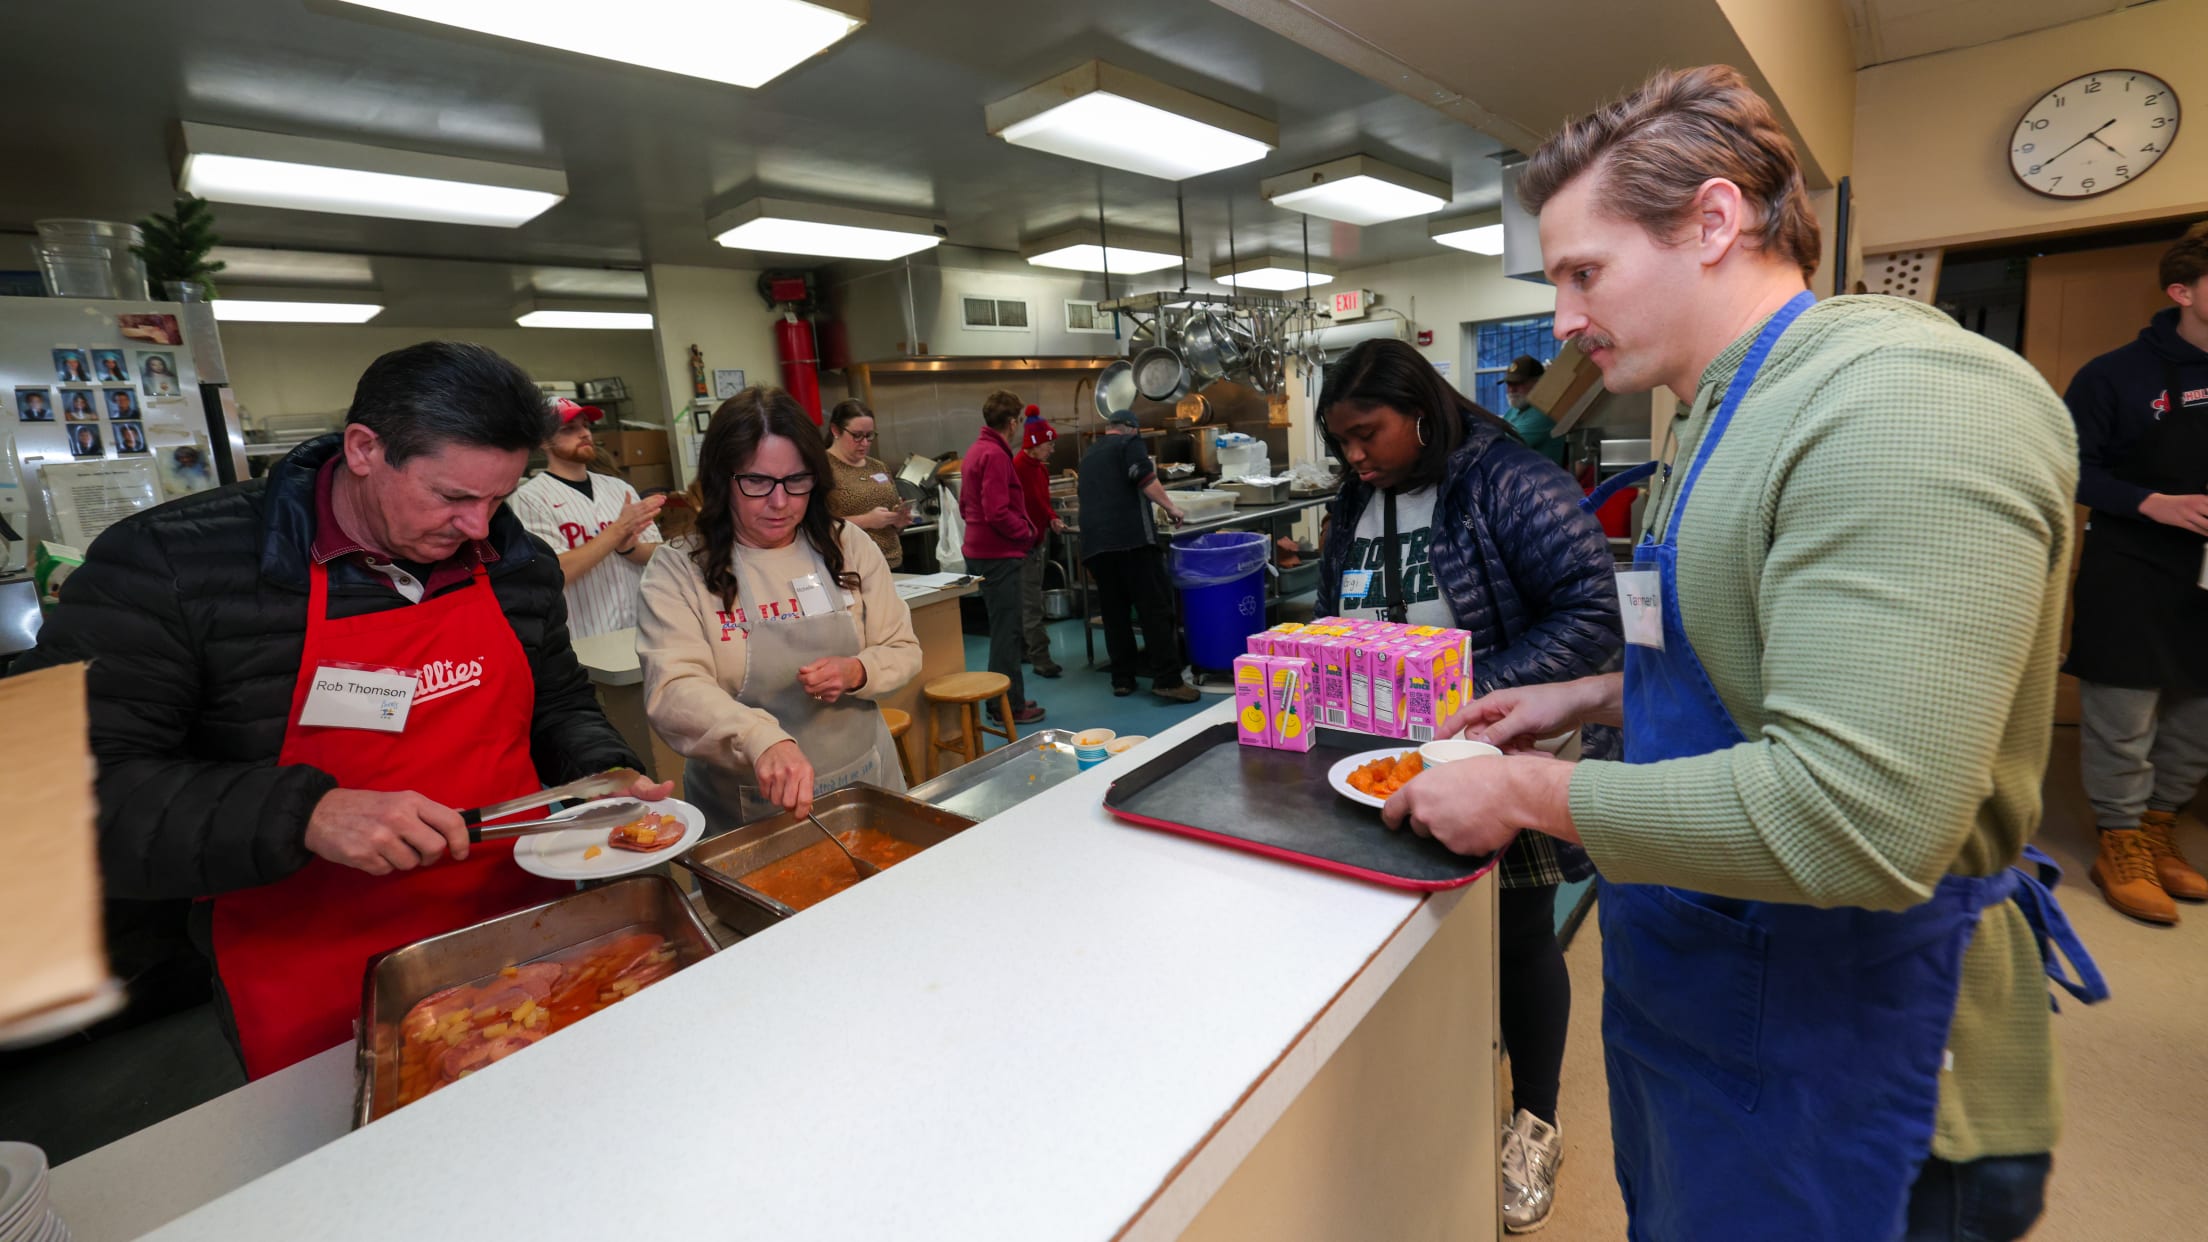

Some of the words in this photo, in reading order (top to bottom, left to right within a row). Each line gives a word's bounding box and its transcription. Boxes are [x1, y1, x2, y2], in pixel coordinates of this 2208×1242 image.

[2084, 81, 2101, 94] 12
[2125, 81, 2130, 92] 1
[2055, 97, 2066, 107] 11
[2144, 94, 2158, 106] 2
[2030, 118, 2049, 131] 10
[2151, 117, 2166, 129] 3
[2021, 143, 2035, 154] 9
[2140, 142, 2154, 153] 4
[2028, 164, 2042, 175] 8
[2115, 165, 2129, 176] 5
[2050, 176, 2063, 187] 7
[2081, 178, 2095, 189] 6
[1336, 292, 1358, 312] EXIT
[316, 680, 343, 692] Rob
[347, 682, 406, 698] Thomson
